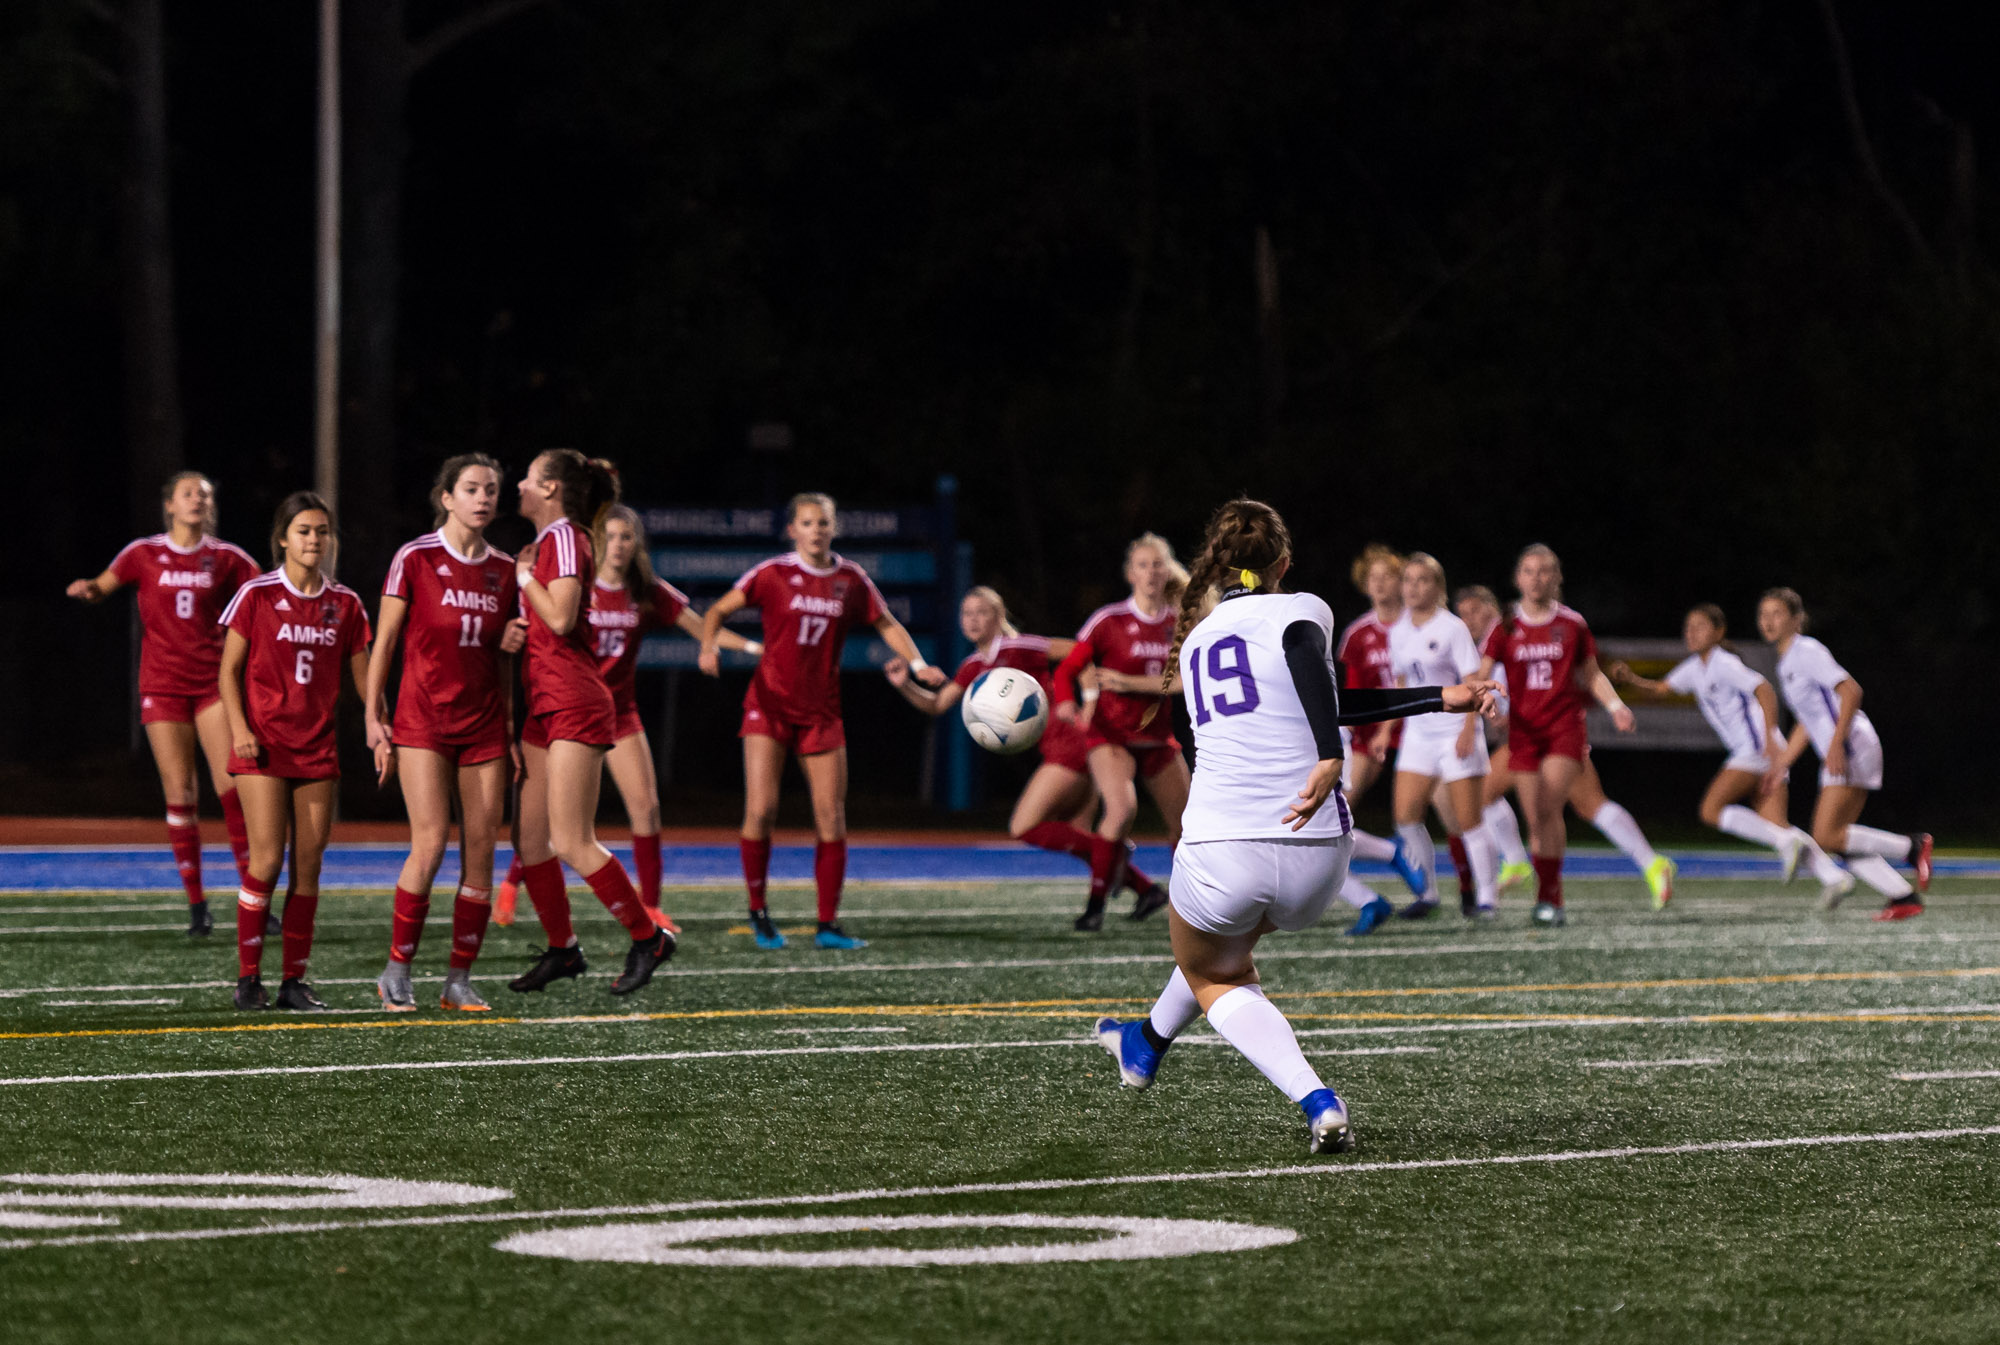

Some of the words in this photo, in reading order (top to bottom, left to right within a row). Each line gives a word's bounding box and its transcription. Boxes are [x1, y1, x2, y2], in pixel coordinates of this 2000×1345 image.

[159, 569, 212, 588] AMHS
[176, 589, 194, 619] 8
[441, 588, 498, 613] AMHS
[789, 593, 843, 617] AMHS
[459, 613, 483, 647] 11
[588, 609, 639, 628] AMHS
[797, 614, 829, 645] 17
[276, 623, 337, 646] AMHS
[596, 628, 625, 657] 16
[1130, 641, 1169, 659] AMH
[1514, 642, 1563, 662] AMHS
[294, 650, 315, 685] 6
[1190, 634, 1261, 727] 19
[1526, 660, 1553, 690] 12
